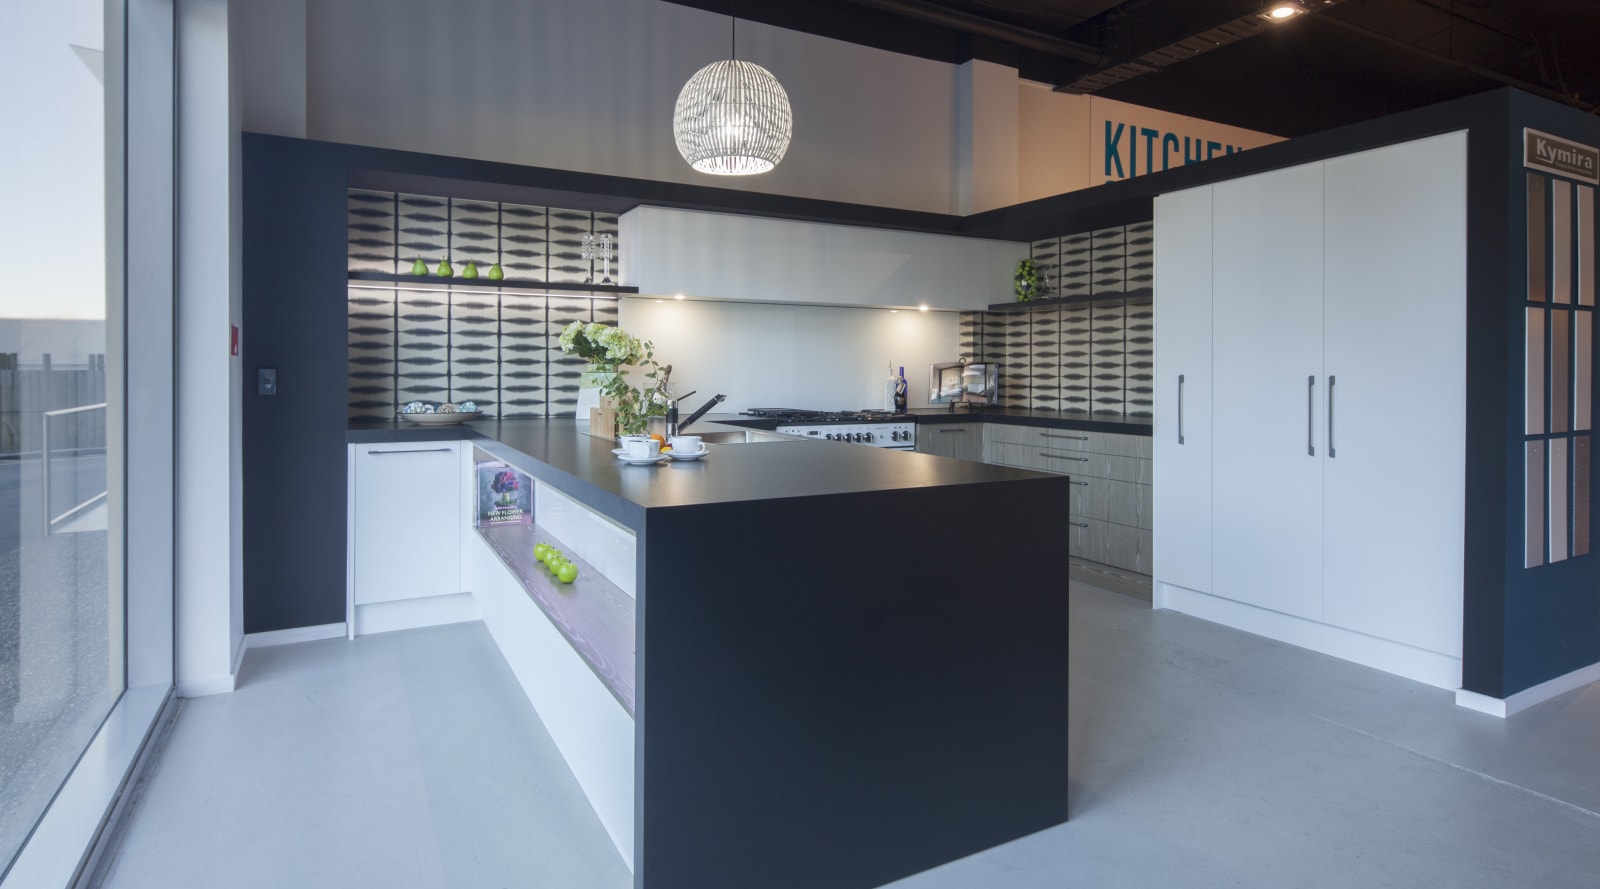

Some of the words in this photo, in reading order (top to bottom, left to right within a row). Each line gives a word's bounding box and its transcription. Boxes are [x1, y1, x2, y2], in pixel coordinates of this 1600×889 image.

[1105, 120, 1243, 178] KITCH
[1536, 138, 1593, 168] Kymira
[502, 508, 523, 516] FLOWER
